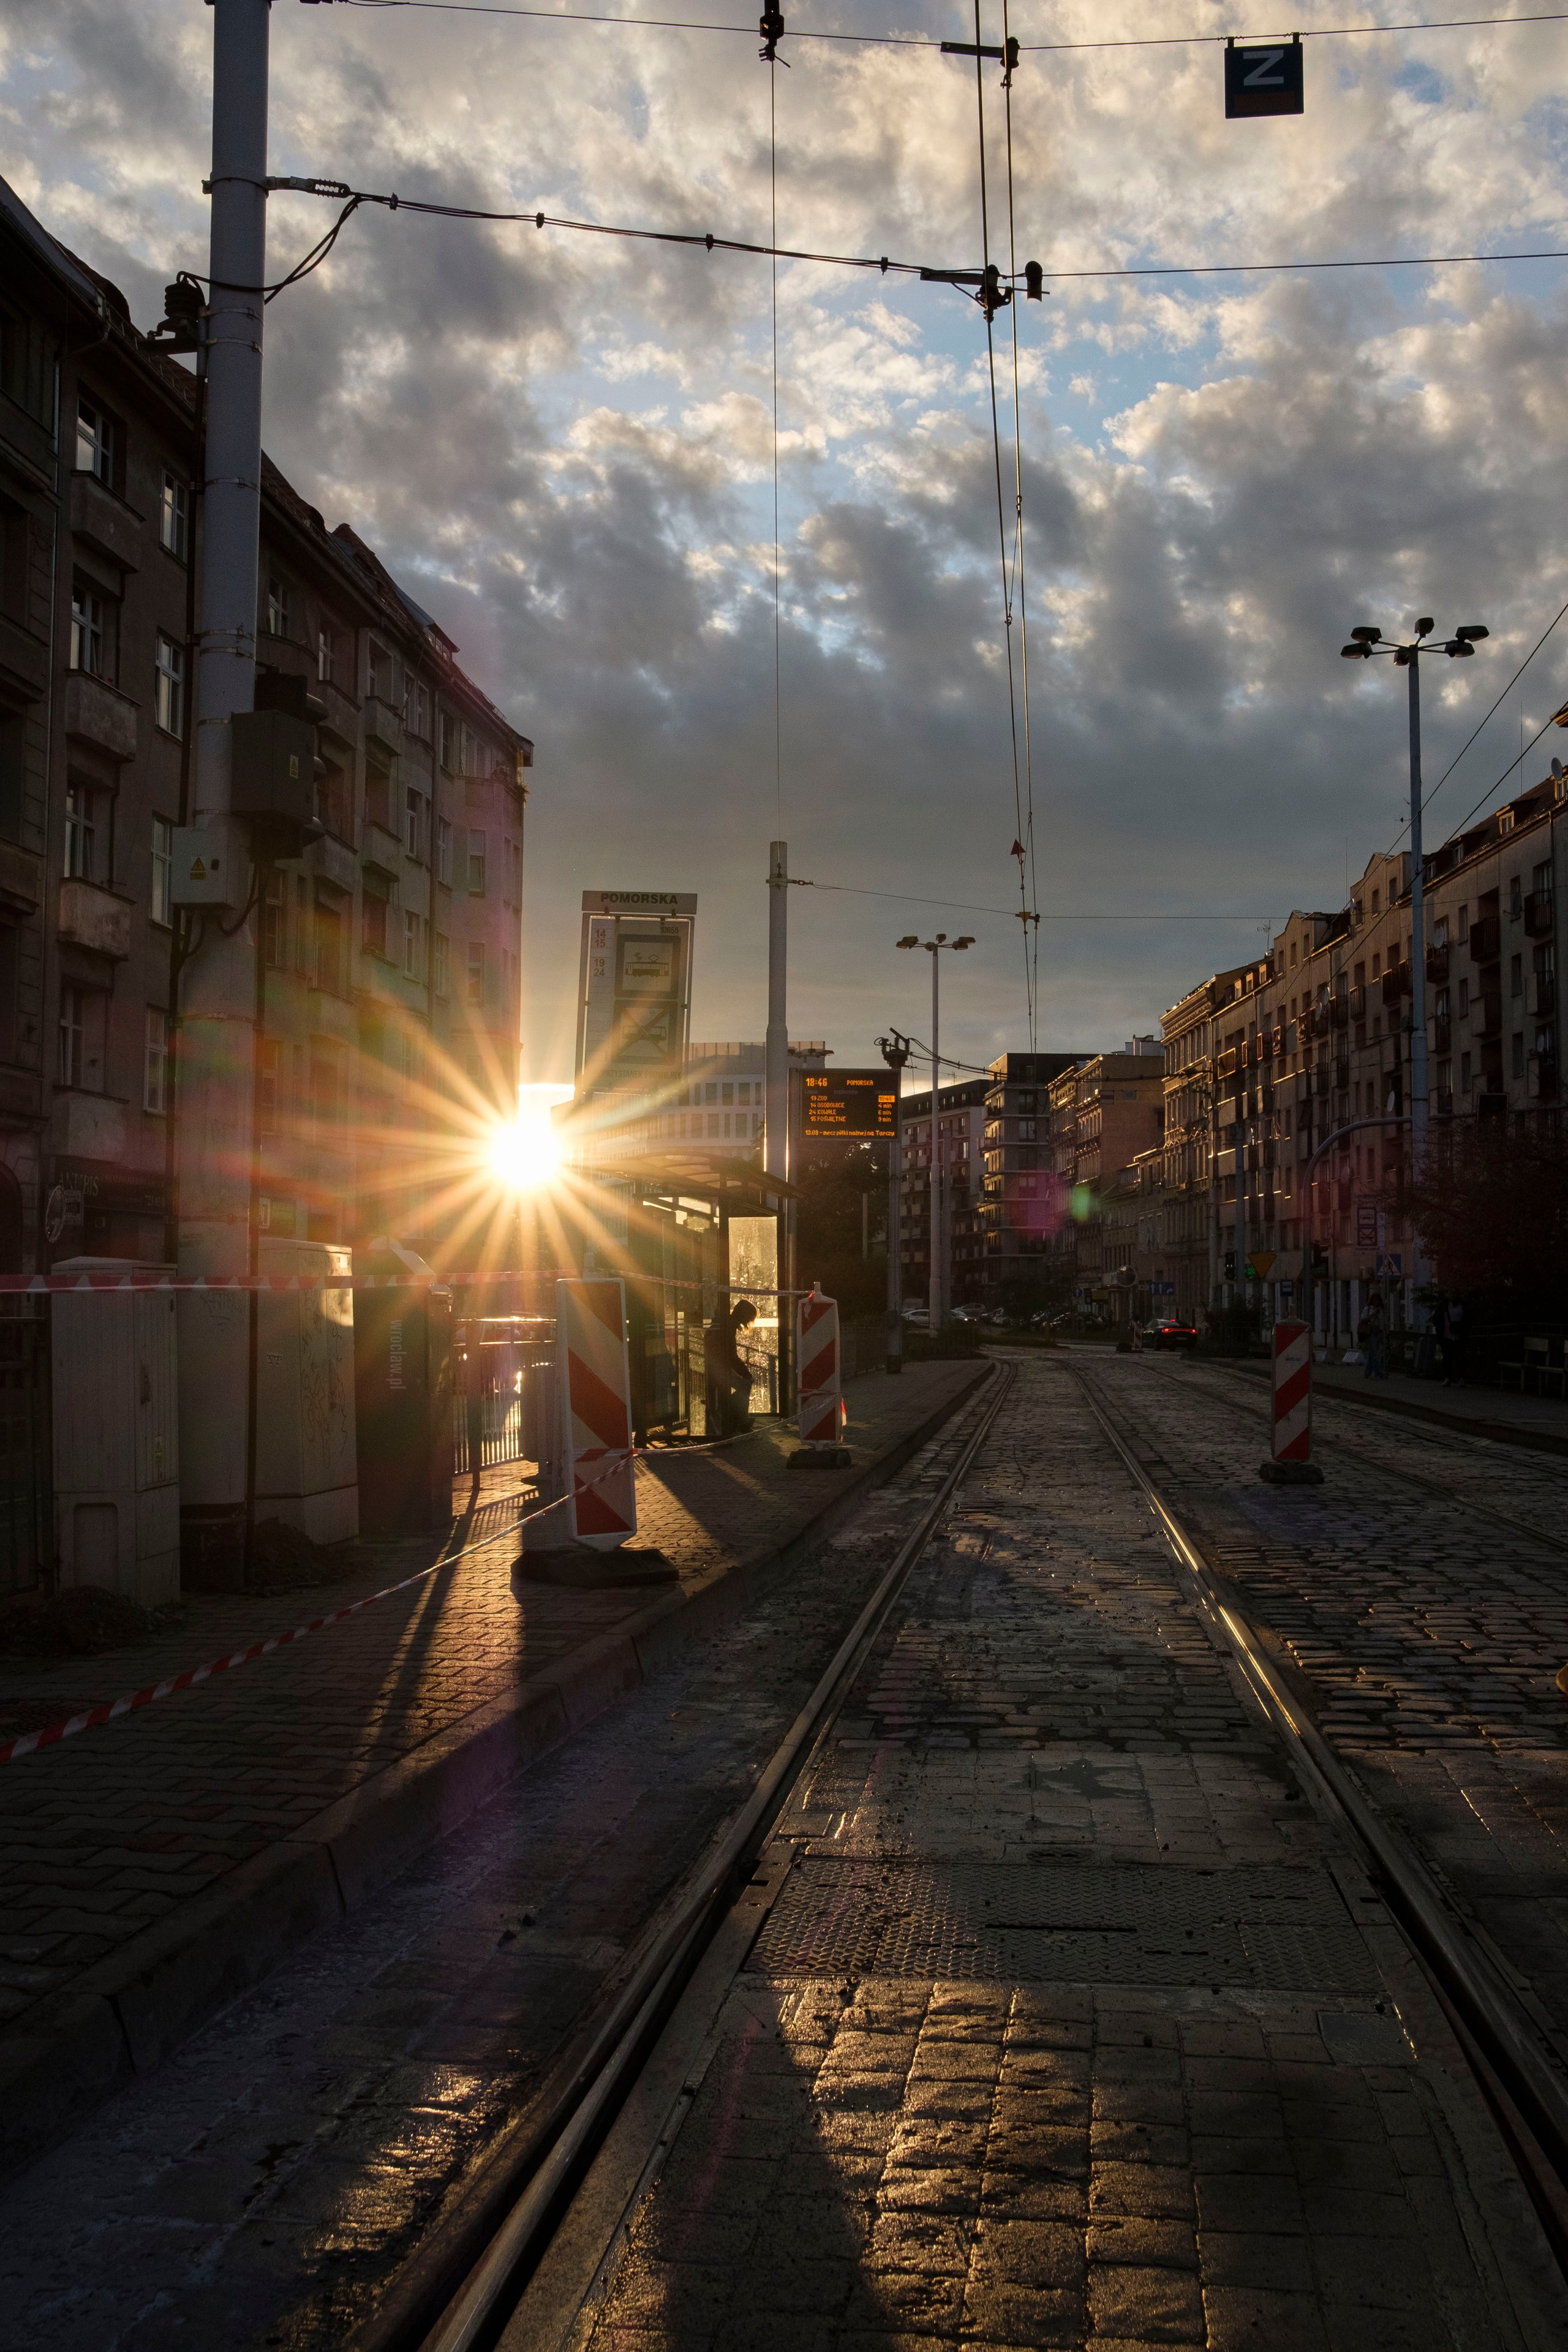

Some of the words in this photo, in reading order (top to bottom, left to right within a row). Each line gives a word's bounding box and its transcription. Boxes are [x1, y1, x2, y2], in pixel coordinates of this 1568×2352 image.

[601, 892, 678, 905] POMORSKA
[595, 929, 606, 938] 14
[595, 939, 606, 948] 15
[594, 959, 605, 967] 19
[594, 968, 605, 977] 24
[601, 1069, 643, 1078] PRZYSTANEK
[805, 1078, 827, 1087] 18:46
[385, 1319, 407, 1389] wroclaw.pl
